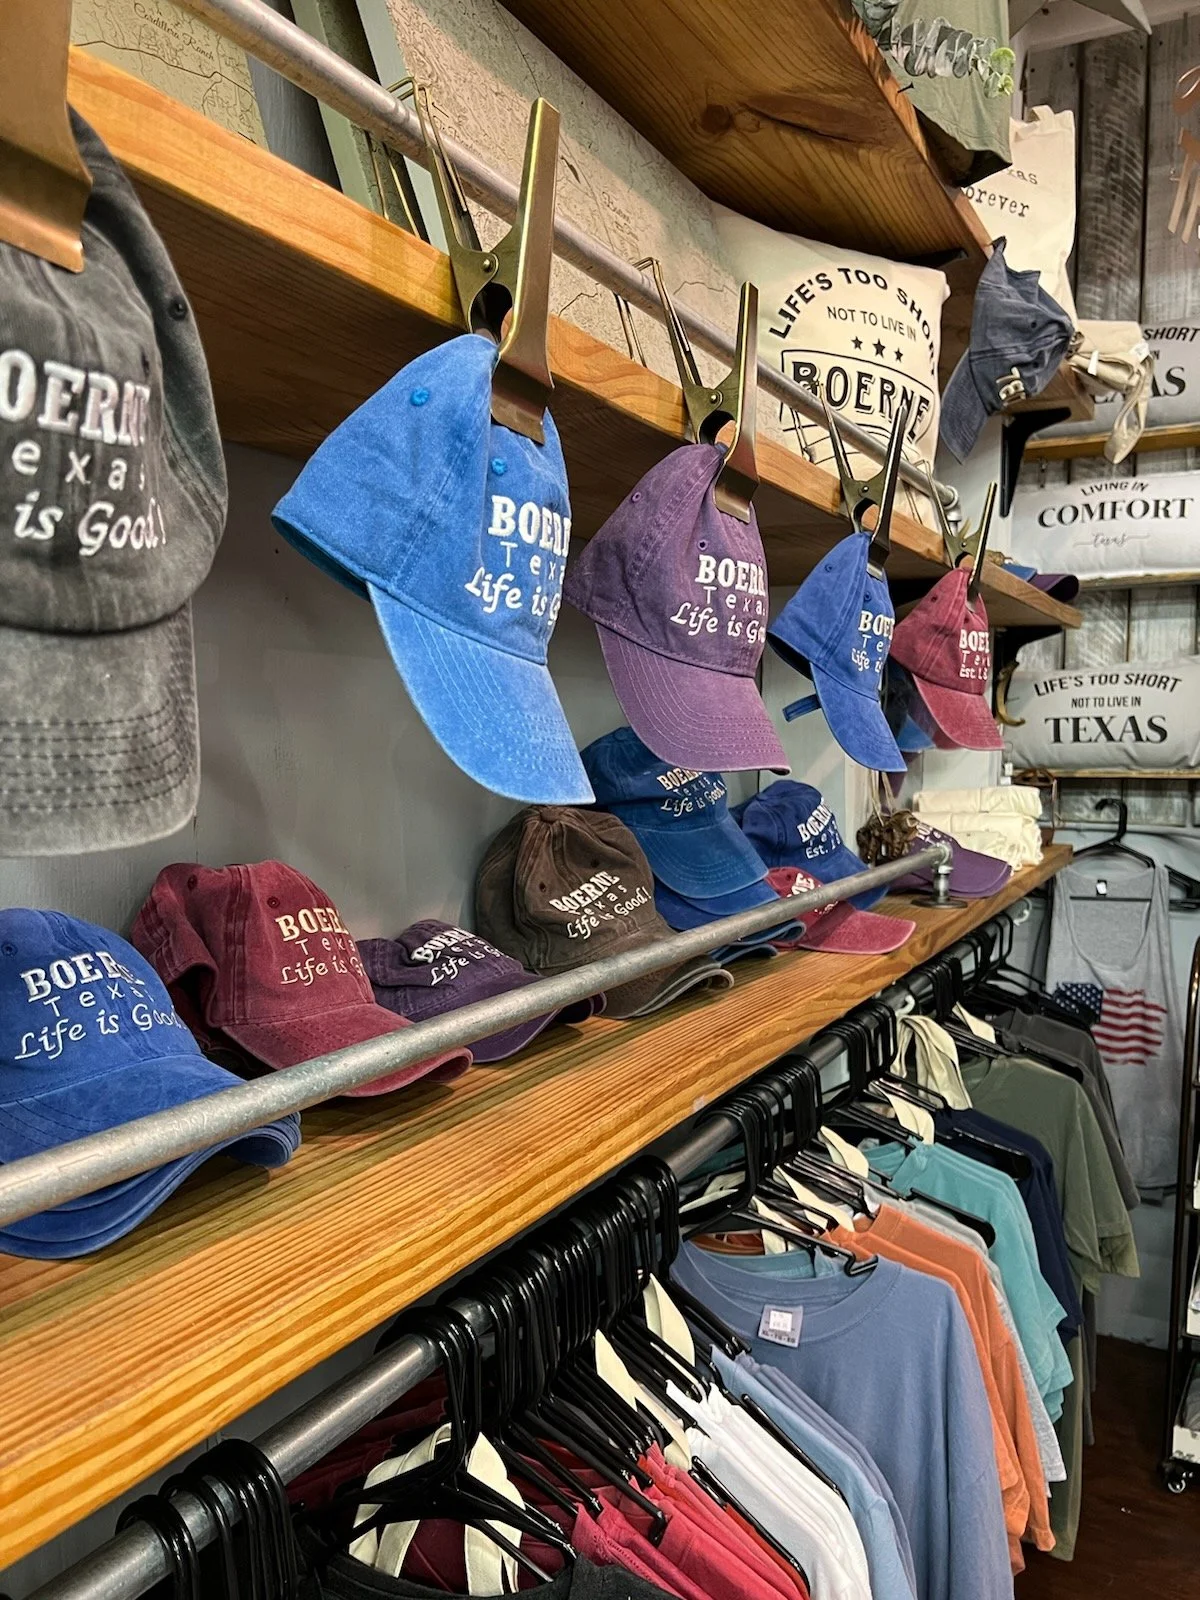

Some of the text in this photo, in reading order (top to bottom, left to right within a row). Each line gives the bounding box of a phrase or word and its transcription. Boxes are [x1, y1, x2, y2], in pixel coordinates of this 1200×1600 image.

[965, 186, 1029, 217] orever
[769, 272, 833, 339] LIFE'S
[837, 267, 888, 290] TOO
[827, 306, 917, 342] NOT TO LIVE IN
[1142, 327, 1200, 342] SHORT
[1081, 481, 1150, 497] LIVING IN
[14, 489, 64, 540] is
[1037, 497, 1195, 529] COMFORT
[464, 566, 523, 614] Life
[531, 586, 548, 617] is
[702, 585, 766, 617] Texa
[670, 602, 719, 636] Life
[727, 615, 743, 637] is
[1034, 672, 1182, 698] LIFE'S TOO SHORT
[1071, 696, 1142, 709] NOT TO LIVE IN
[1044, 714, 1168, 744] TEXAS
[660, 797, 693, 817] Life
[695, 796, 706, 809] is
[805, 844, 829, 859] Est.
[549, 870, 620, 912] BOERNE
[567, 914, 600, 939] Life
[613, 886, 652, 916] Good!
[280, 957, 329, 987] Life
[332, 955, 348, 974] is
[430, 956, 470, 986] Life
[14, 1018, 87, 1060] Life
[96, 1008, 120, 1035] is
